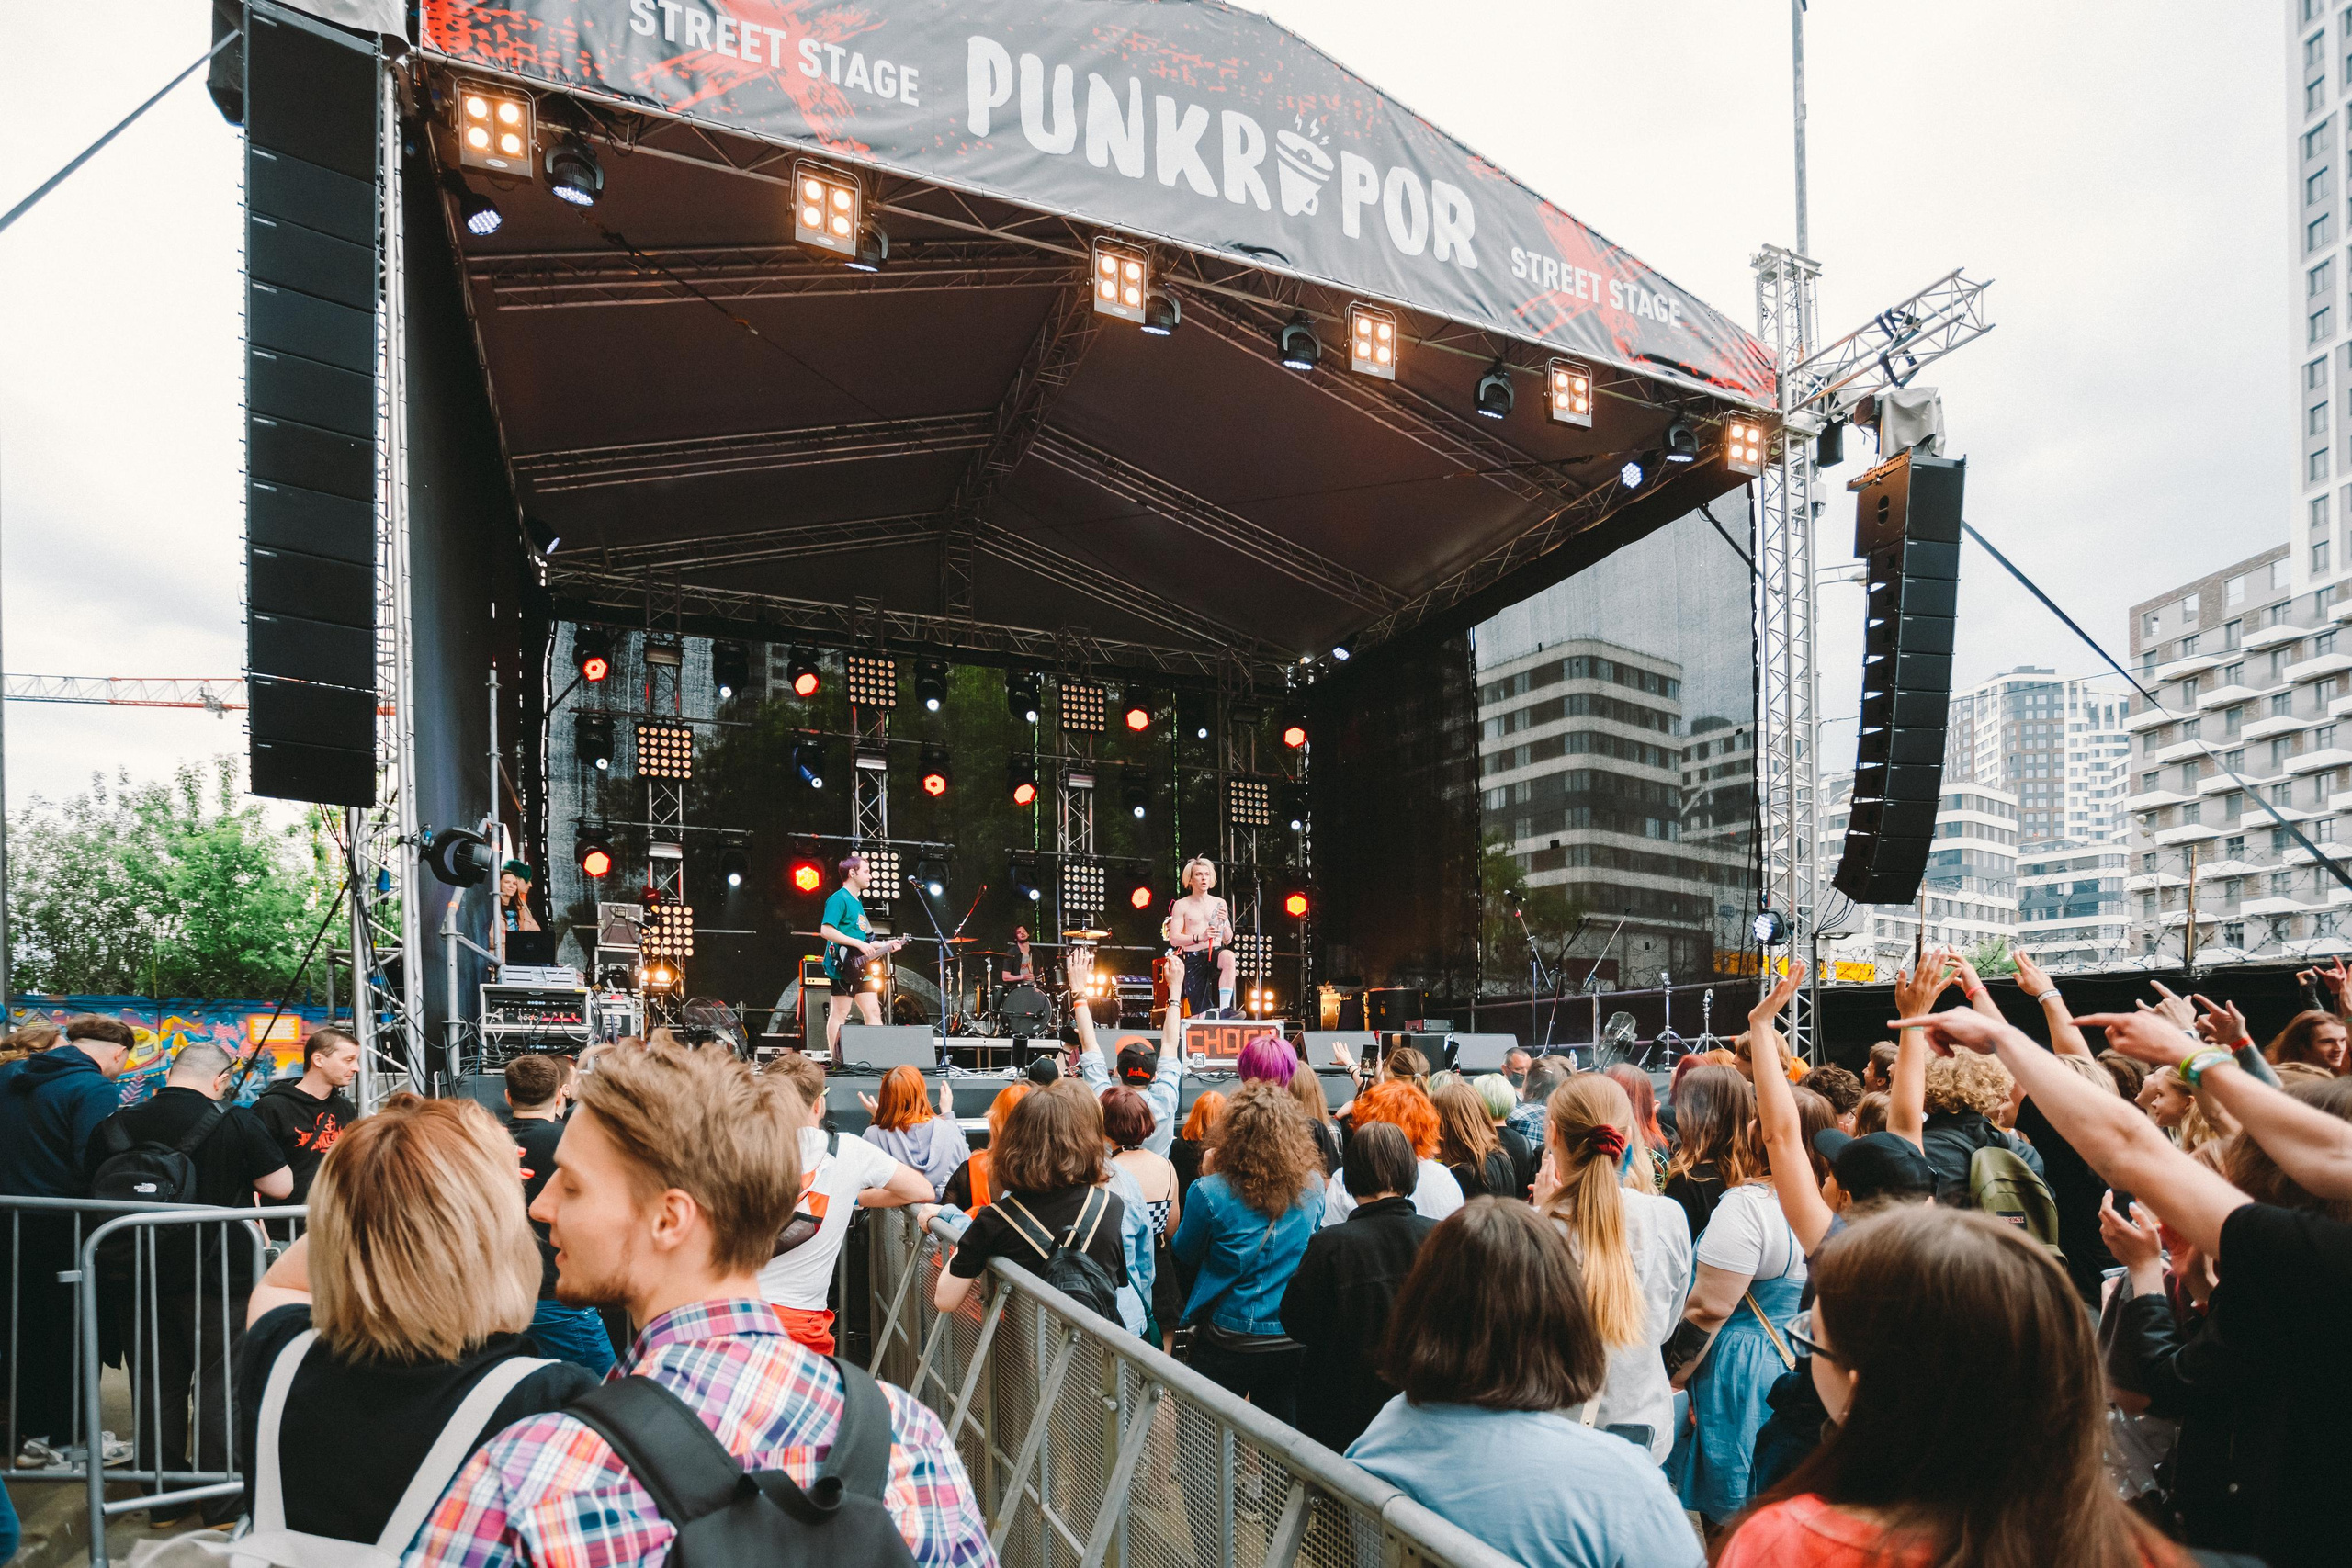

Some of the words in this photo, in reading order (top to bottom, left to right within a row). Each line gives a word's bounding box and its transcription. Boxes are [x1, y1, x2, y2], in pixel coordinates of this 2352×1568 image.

[630, 0, 786, 68] STREET
[798, 38, 920, 107] STAGE
[1510, 246, 1602, 304] STREET
[1609, 279, 1681, 330] STAGE
